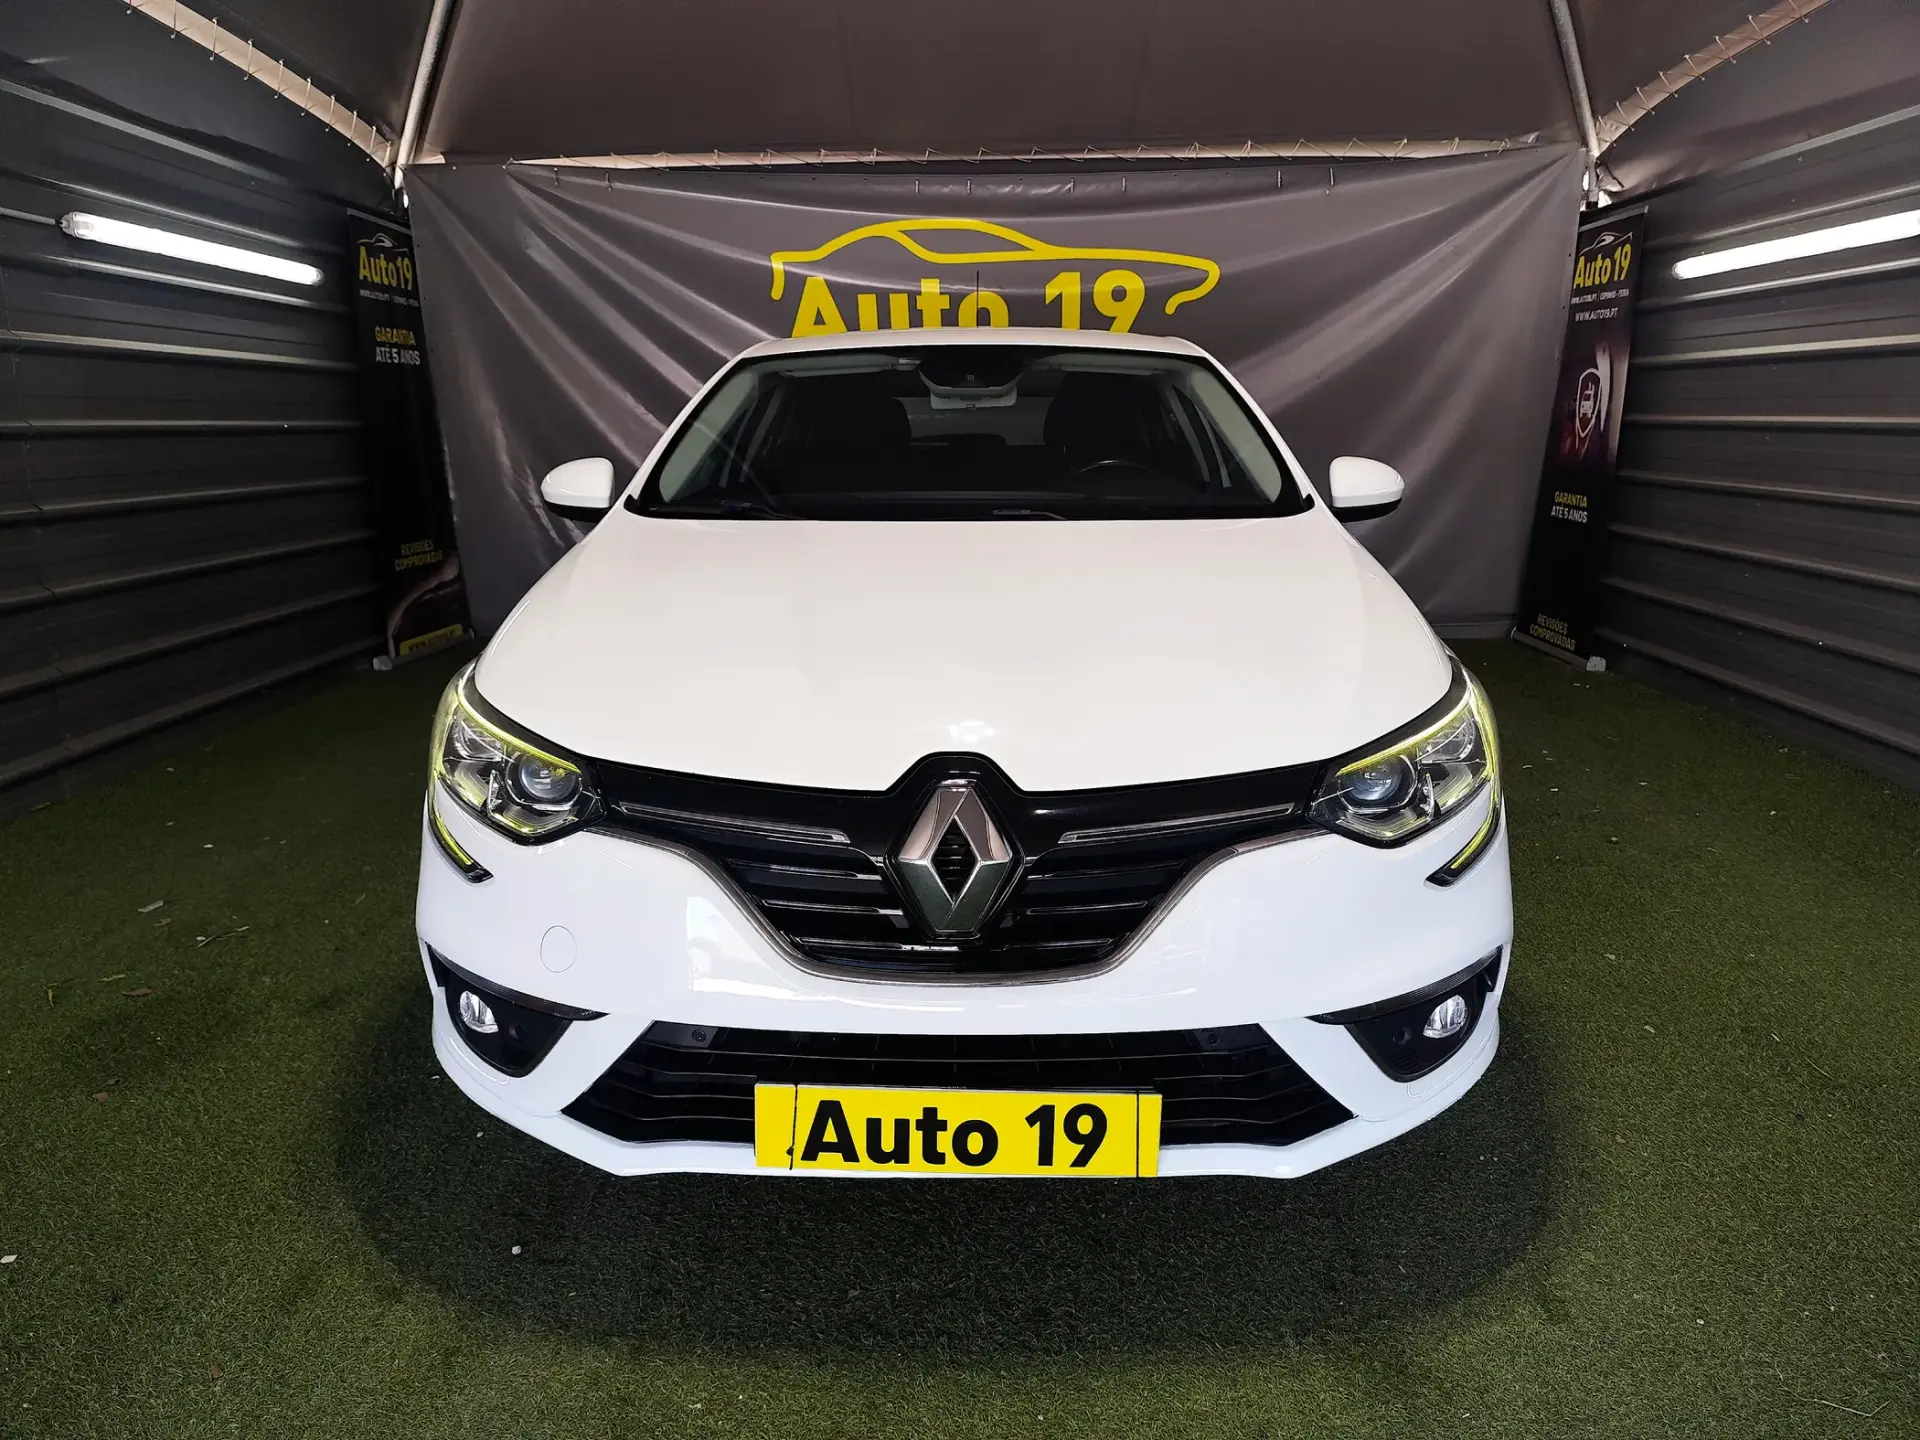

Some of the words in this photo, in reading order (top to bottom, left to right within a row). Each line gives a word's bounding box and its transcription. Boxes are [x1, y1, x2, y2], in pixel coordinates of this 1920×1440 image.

[359, 245, 397, 288] Auto
[396, 256, 413, 291] 19
[1573, 253, 1611, 289] Auto
[1614, 243, 1632, 281] 19
[791, 276, 1010, 338] Auto
[1044, 269, 1146, 333] 19
[375, 326, 416, 346] GARANTIA
[391, 347, 400, 364] 5
[400, 348, 420, 365] ANOS
[1550, 503, 1564, 518] ATÉ
[1564, 507, 1569, 519] 5
[1568, 508, 1588, 523] ANOS
[1554, 490, 1588, 508] GARANTIA
[1529, 623, 1576, 651] COMPROVADAS
[800, 1099, 999, 1167] Auto
[1024, 1103, 1108, 1168] 19
